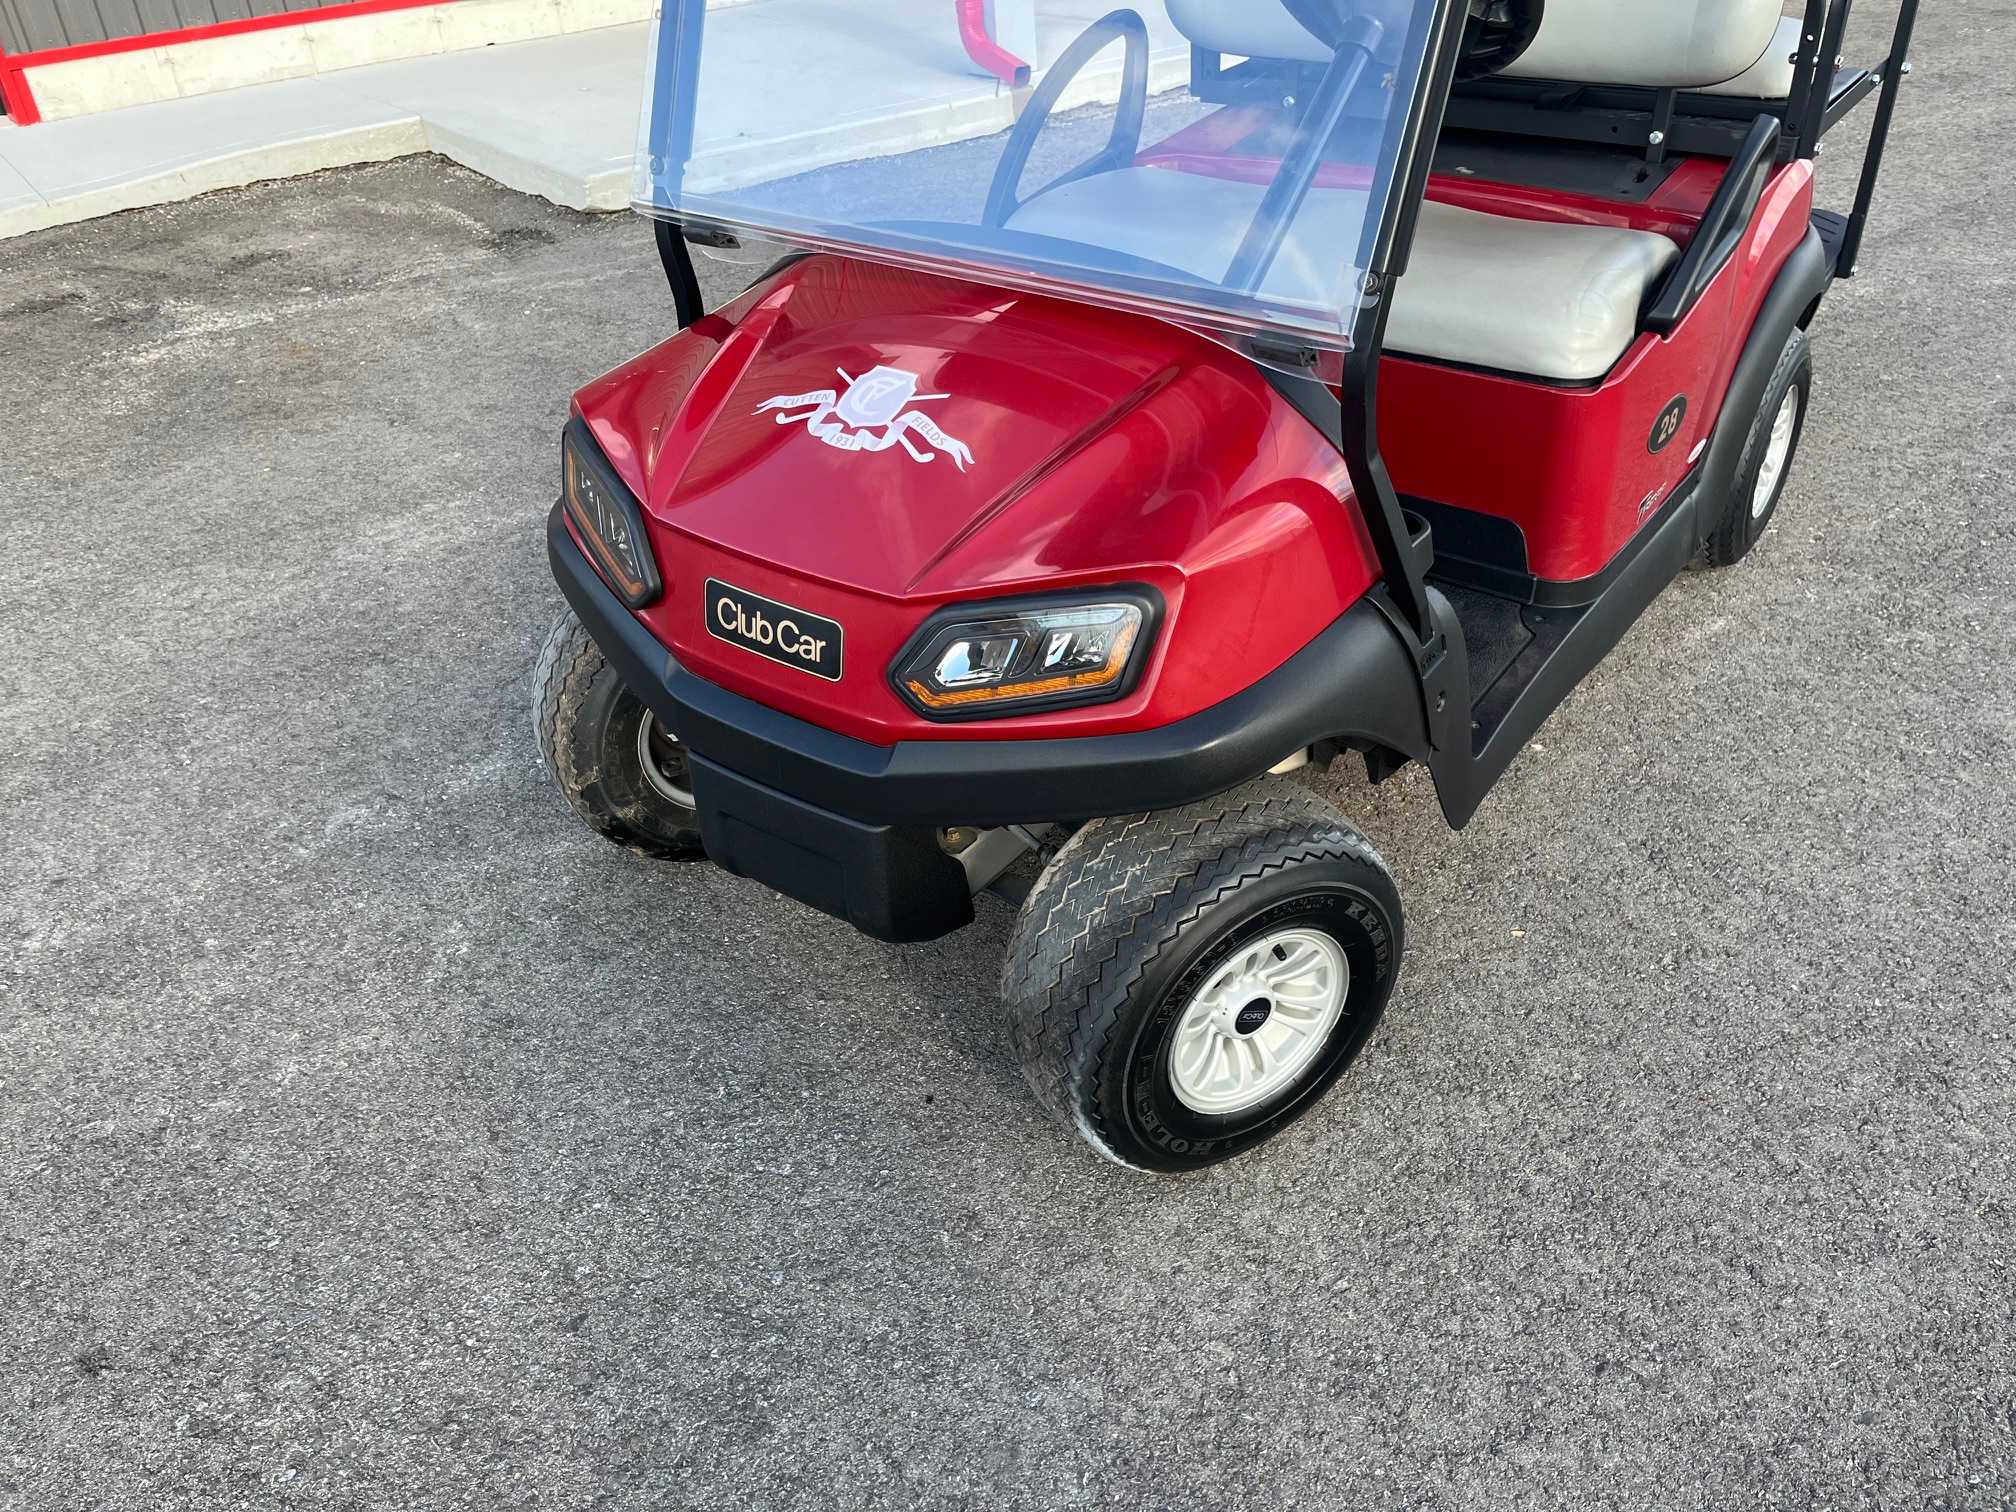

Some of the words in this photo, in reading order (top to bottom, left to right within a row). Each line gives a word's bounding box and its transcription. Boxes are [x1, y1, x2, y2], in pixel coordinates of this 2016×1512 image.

[783, 392, 831, 407] CUTTEN
[829, 432, 856, 448] 1931
[911, 416, 948, 447] FIELDS
[1657, 406, 1679, 444] 28
[716, 597, 774, 645] Club
[776, 620, 827, 663] Car
